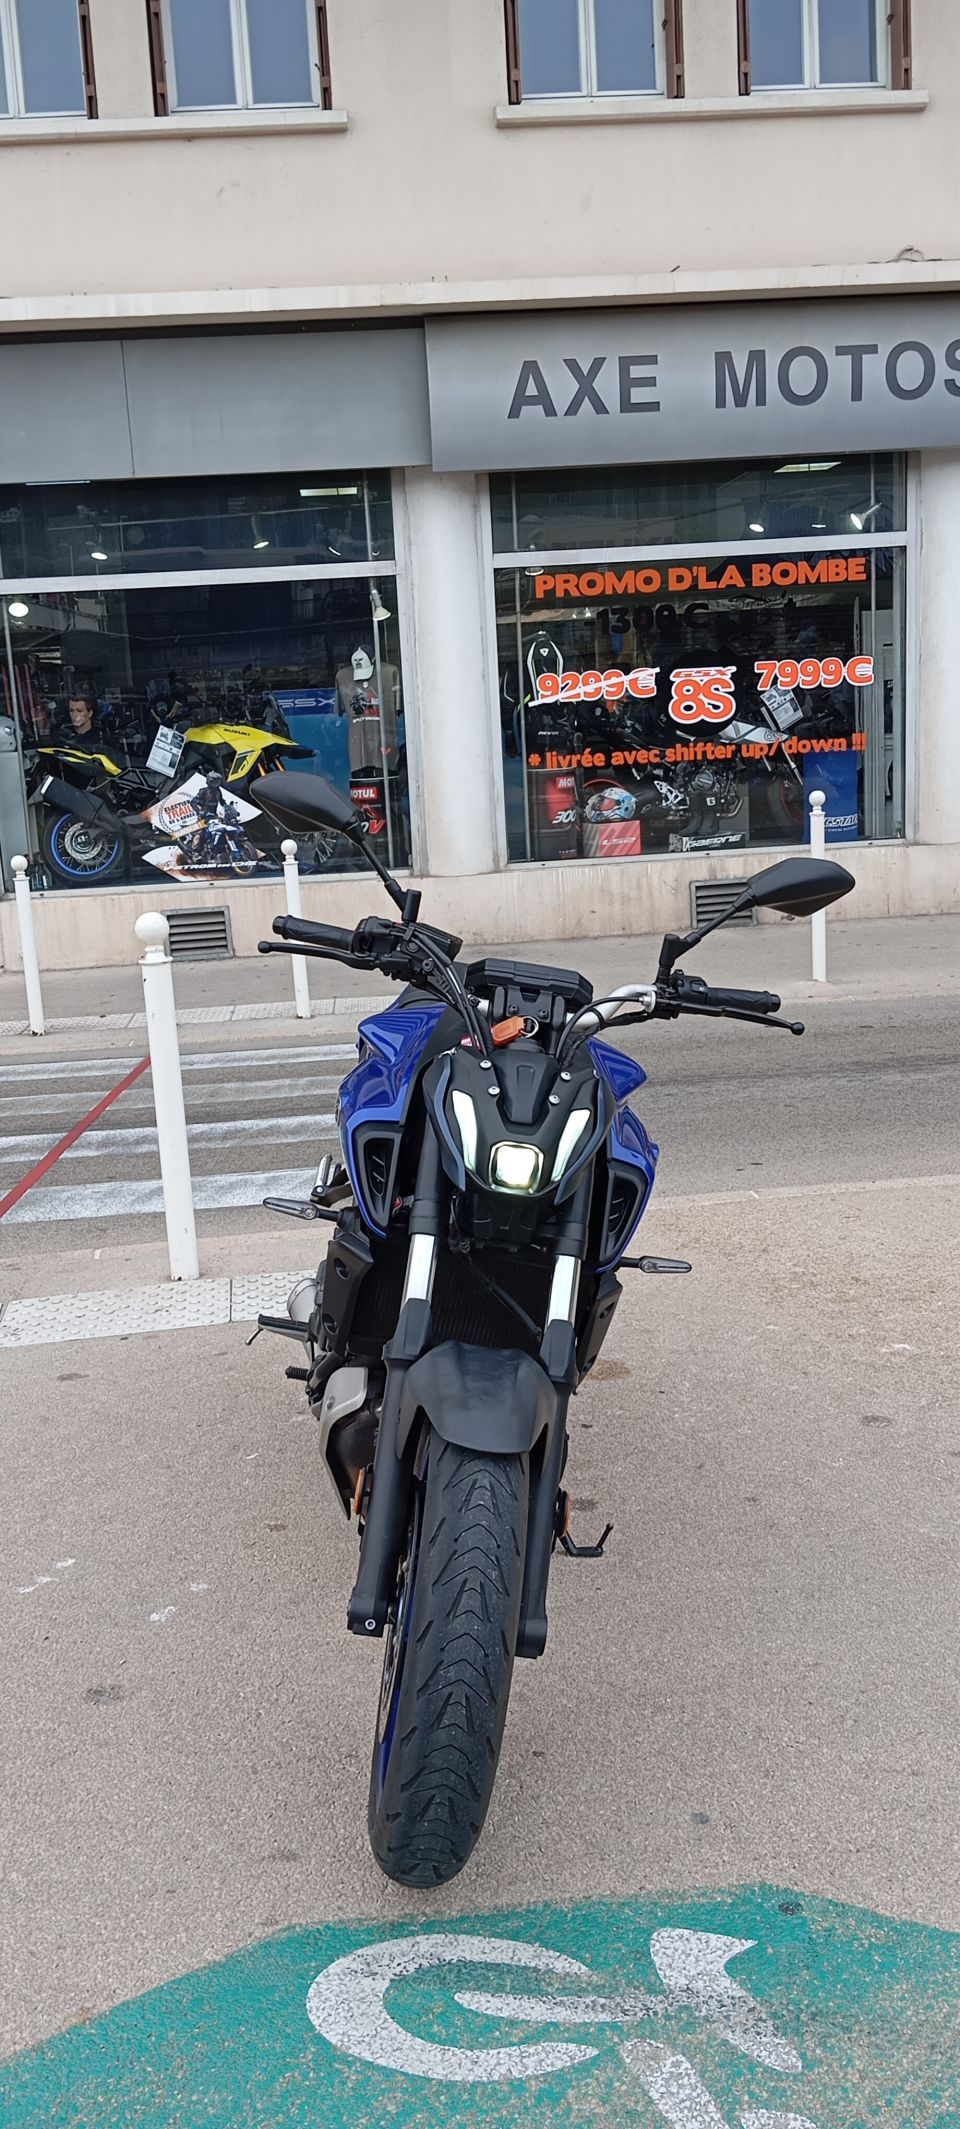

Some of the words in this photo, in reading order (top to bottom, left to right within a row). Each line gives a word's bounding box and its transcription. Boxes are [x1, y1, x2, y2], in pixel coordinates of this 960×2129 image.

[507, 354, 661, 420] AXE
[534, 568, 662, 599] PROMO
[667, 562, 746, 594] D'LA
[751, 557, 868, 588] BOMBE
[754, 655, 875, 691] 7999€
[668, 676, 737, 724] 8S
[545, 749, 606, 769] livrée
[611, 749, 661, 766] avec
[665, 738, 733, 763] shifter
